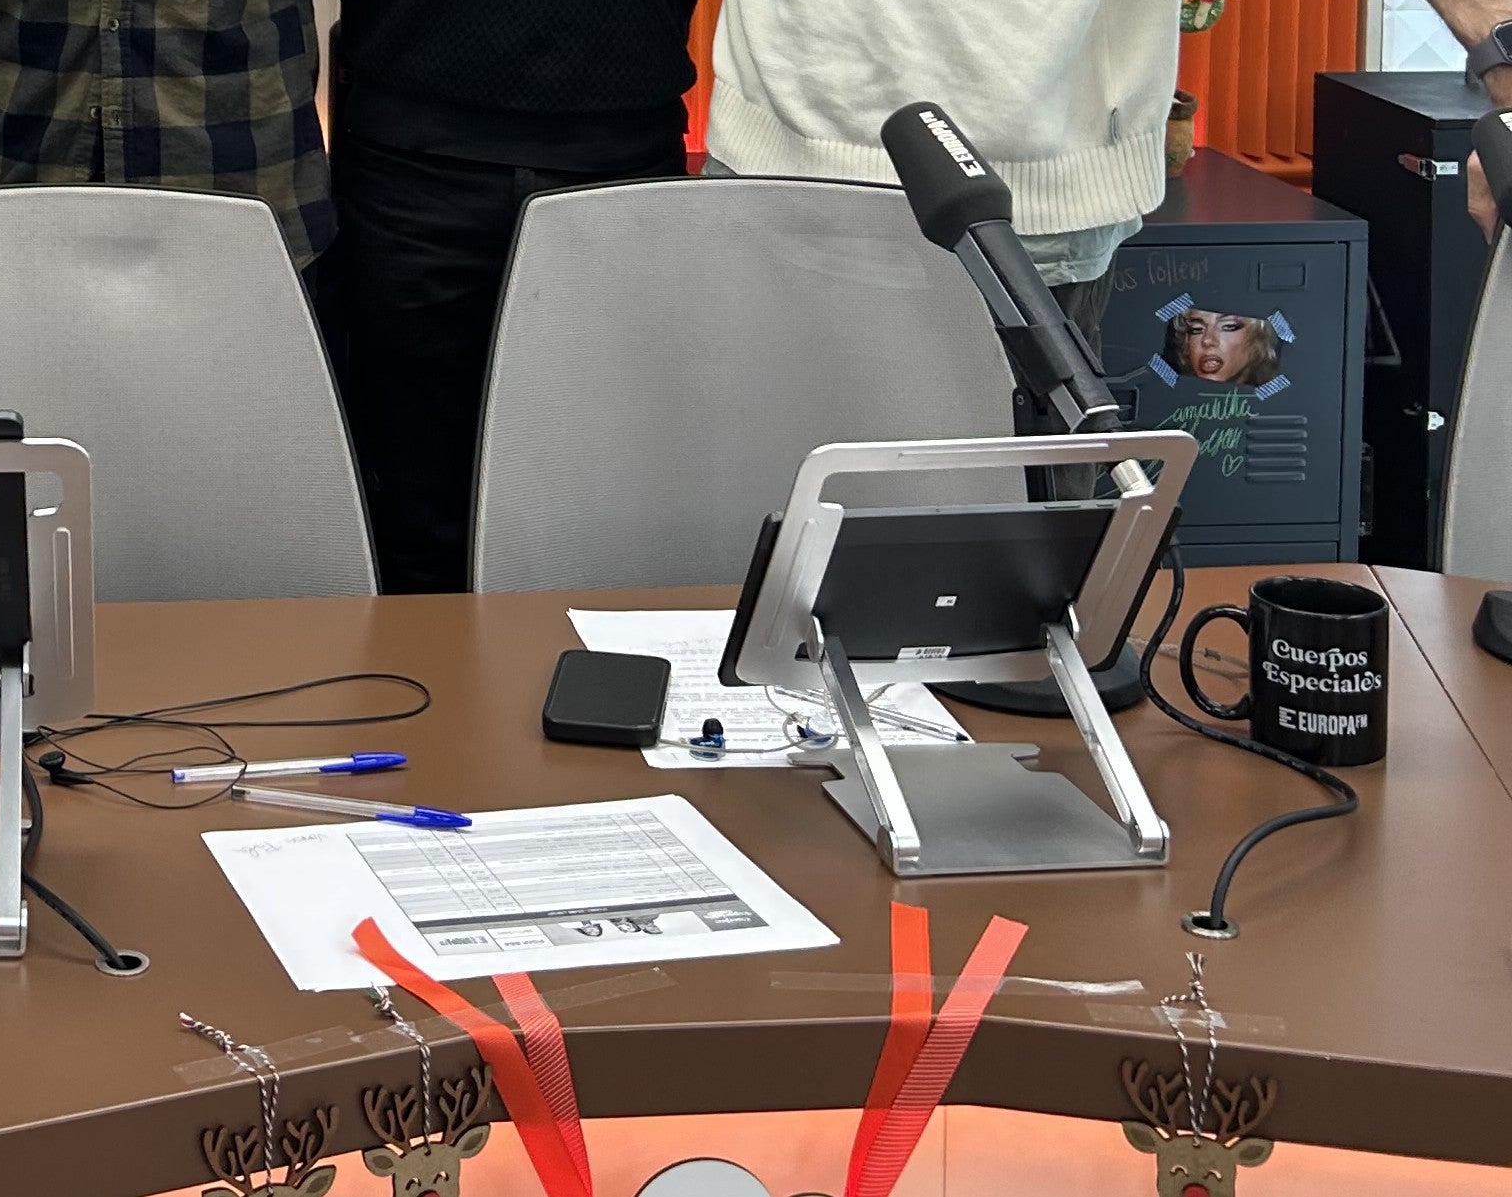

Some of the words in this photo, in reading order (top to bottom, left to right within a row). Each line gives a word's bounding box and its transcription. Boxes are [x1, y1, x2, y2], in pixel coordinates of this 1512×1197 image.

[1271, 639, 1368, 672] Cuerpos
[1262, 661, 1382, 694] Especiales
[1298, 711, 1356, 736] EUROPA
